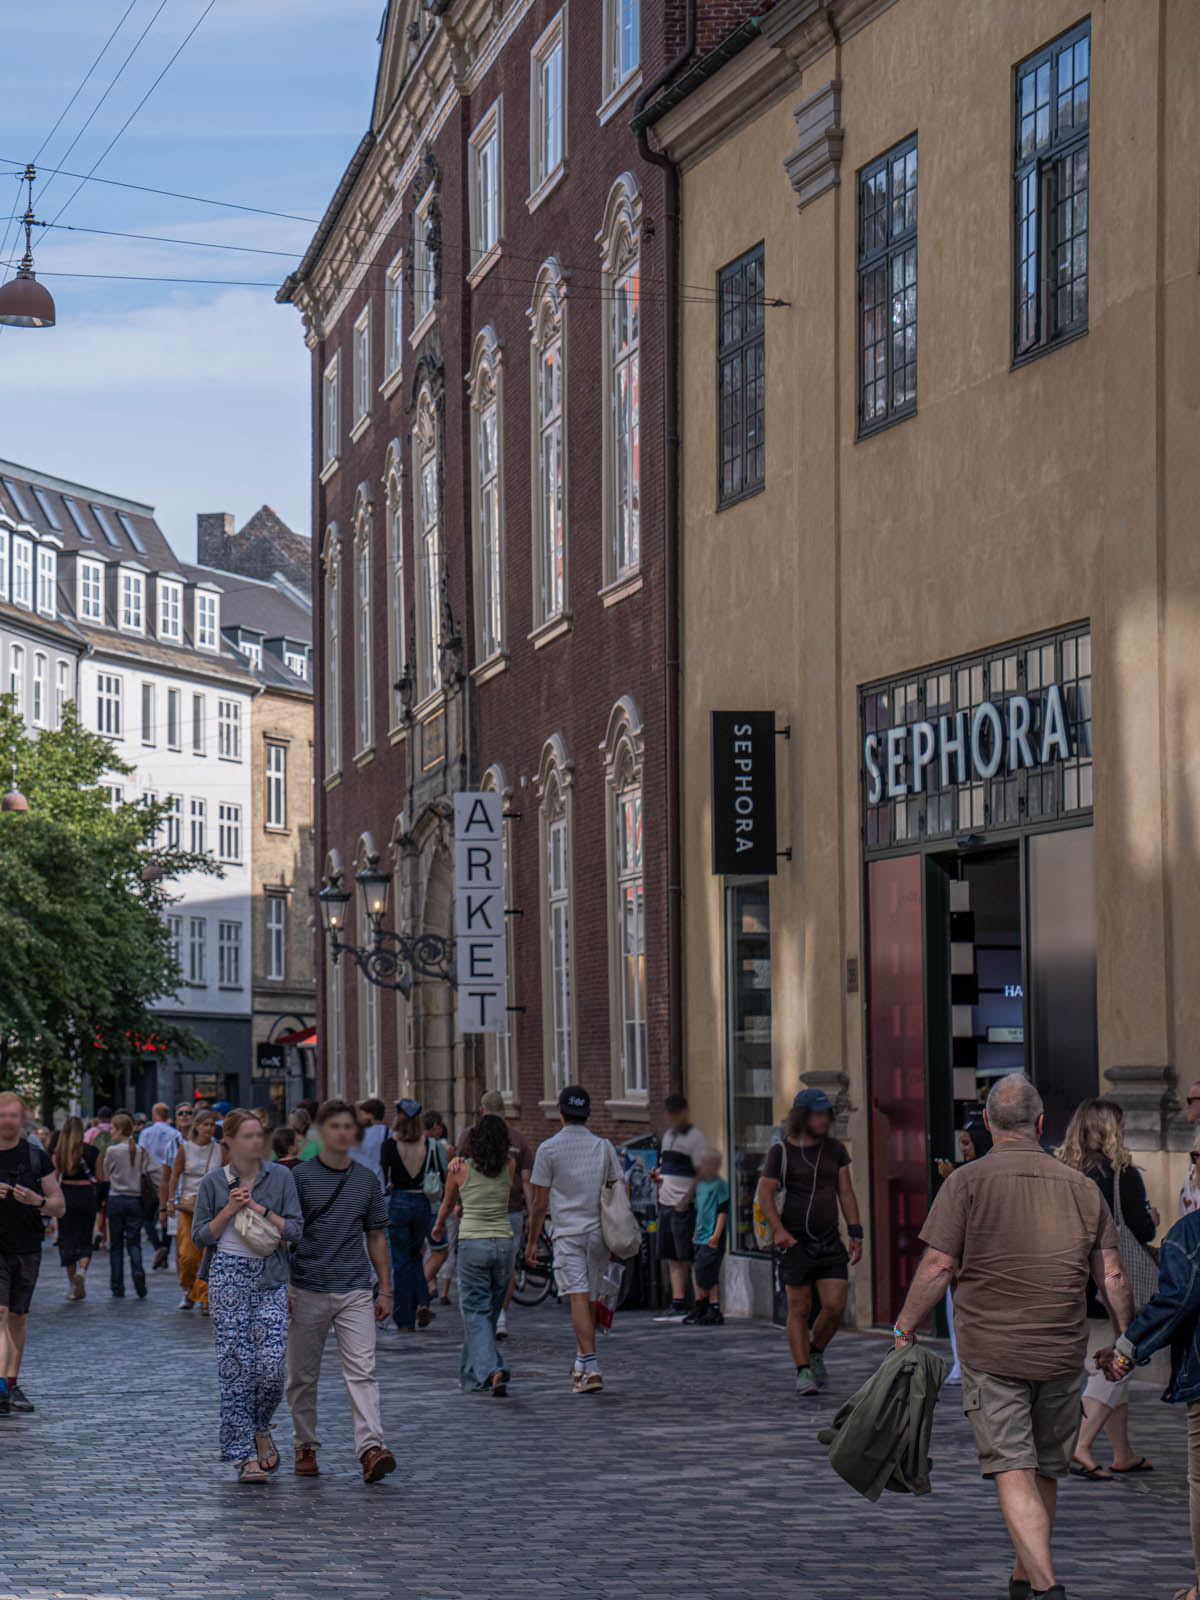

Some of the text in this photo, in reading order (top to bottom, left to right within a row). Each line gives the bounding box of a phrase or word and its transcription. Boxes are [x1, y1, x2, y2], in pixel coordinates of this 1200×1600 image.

[734, 724, 753, 853] SEPHORA
[865, 684, 1069, 804] SEPHORA
[464, 799, 497, 1027] ARKET
